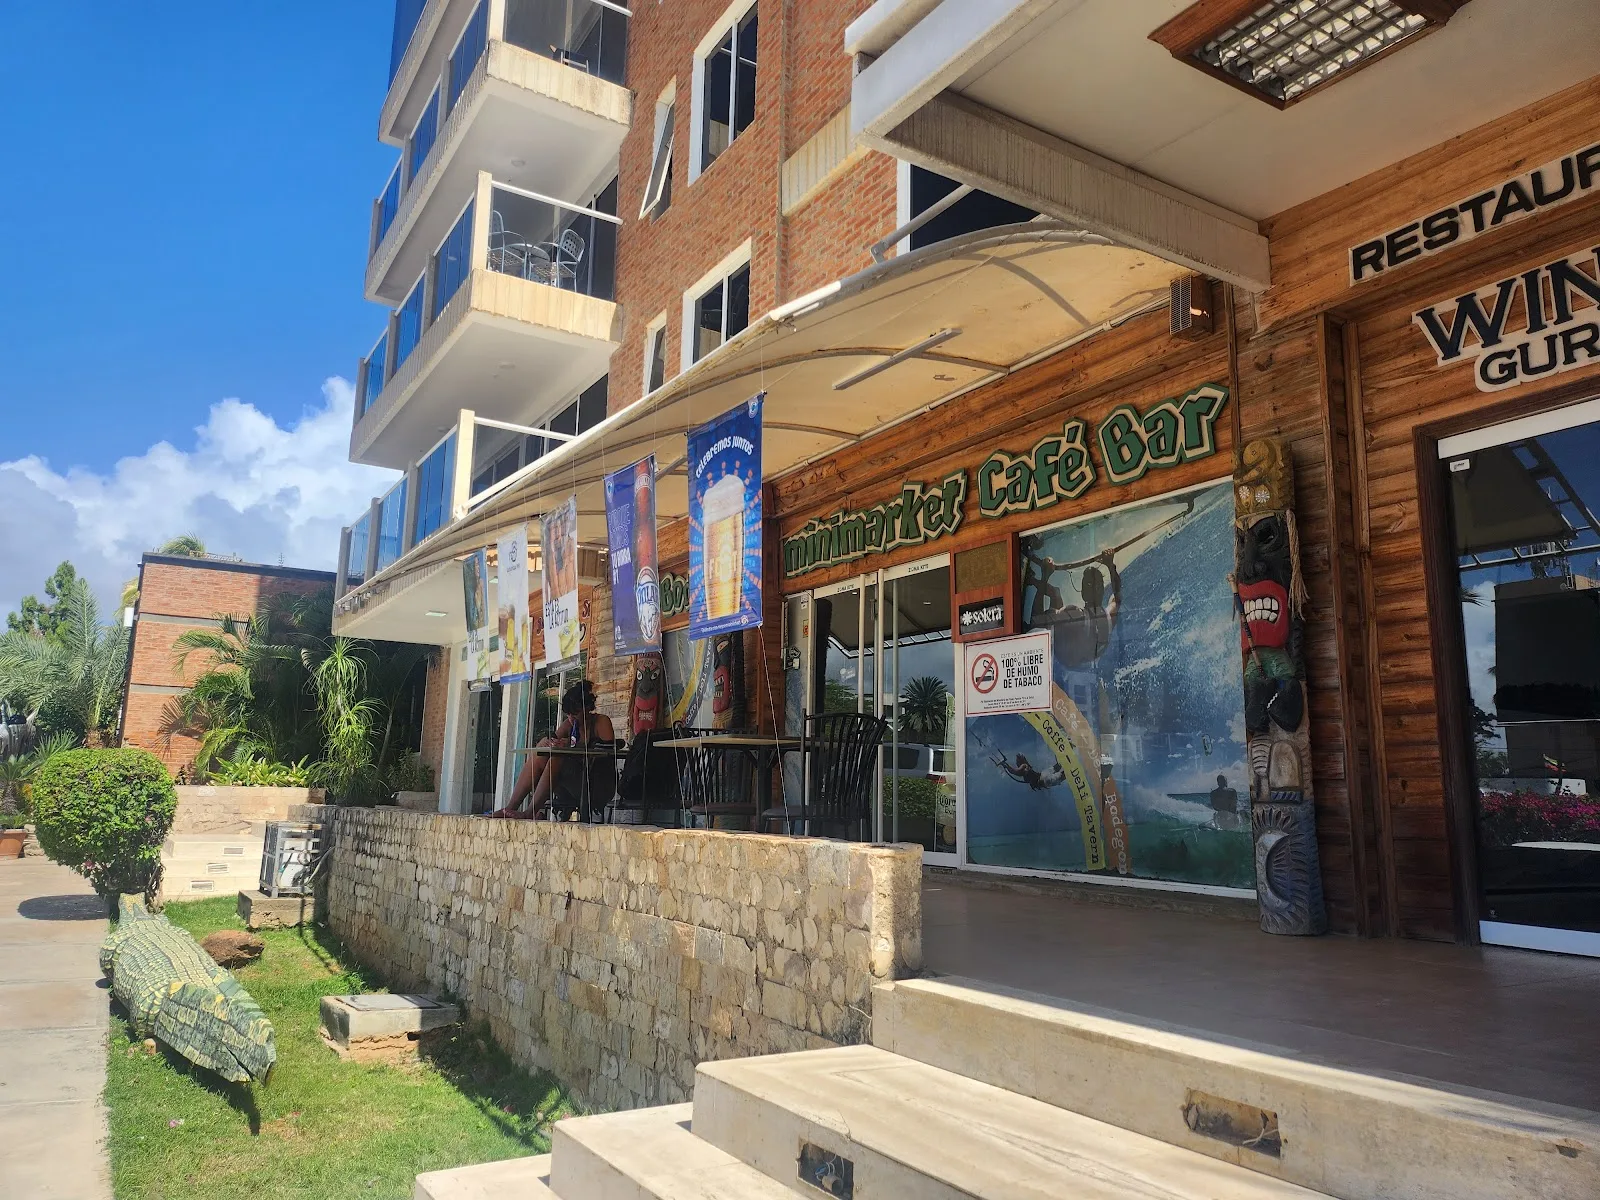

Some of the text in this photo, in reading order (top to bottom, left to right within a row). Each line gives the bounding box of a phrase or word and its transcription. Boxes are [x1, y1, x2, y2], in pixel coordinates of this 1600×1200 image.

[784, 475, 964, 574] minimarket
[979, 421, 1092, 514] Café
[1100, 390, 1223, 481] Bar
[972, 606, 1002, 625] solera
[1001, 654, 1044, 668] 100% LIBRE
[1006, 665, 1039, 678] DE HUMO
[1003, 675, 1043, 689] DE TABACO
[1042, 719, 1100, 865] Coffe Deli Tavern
